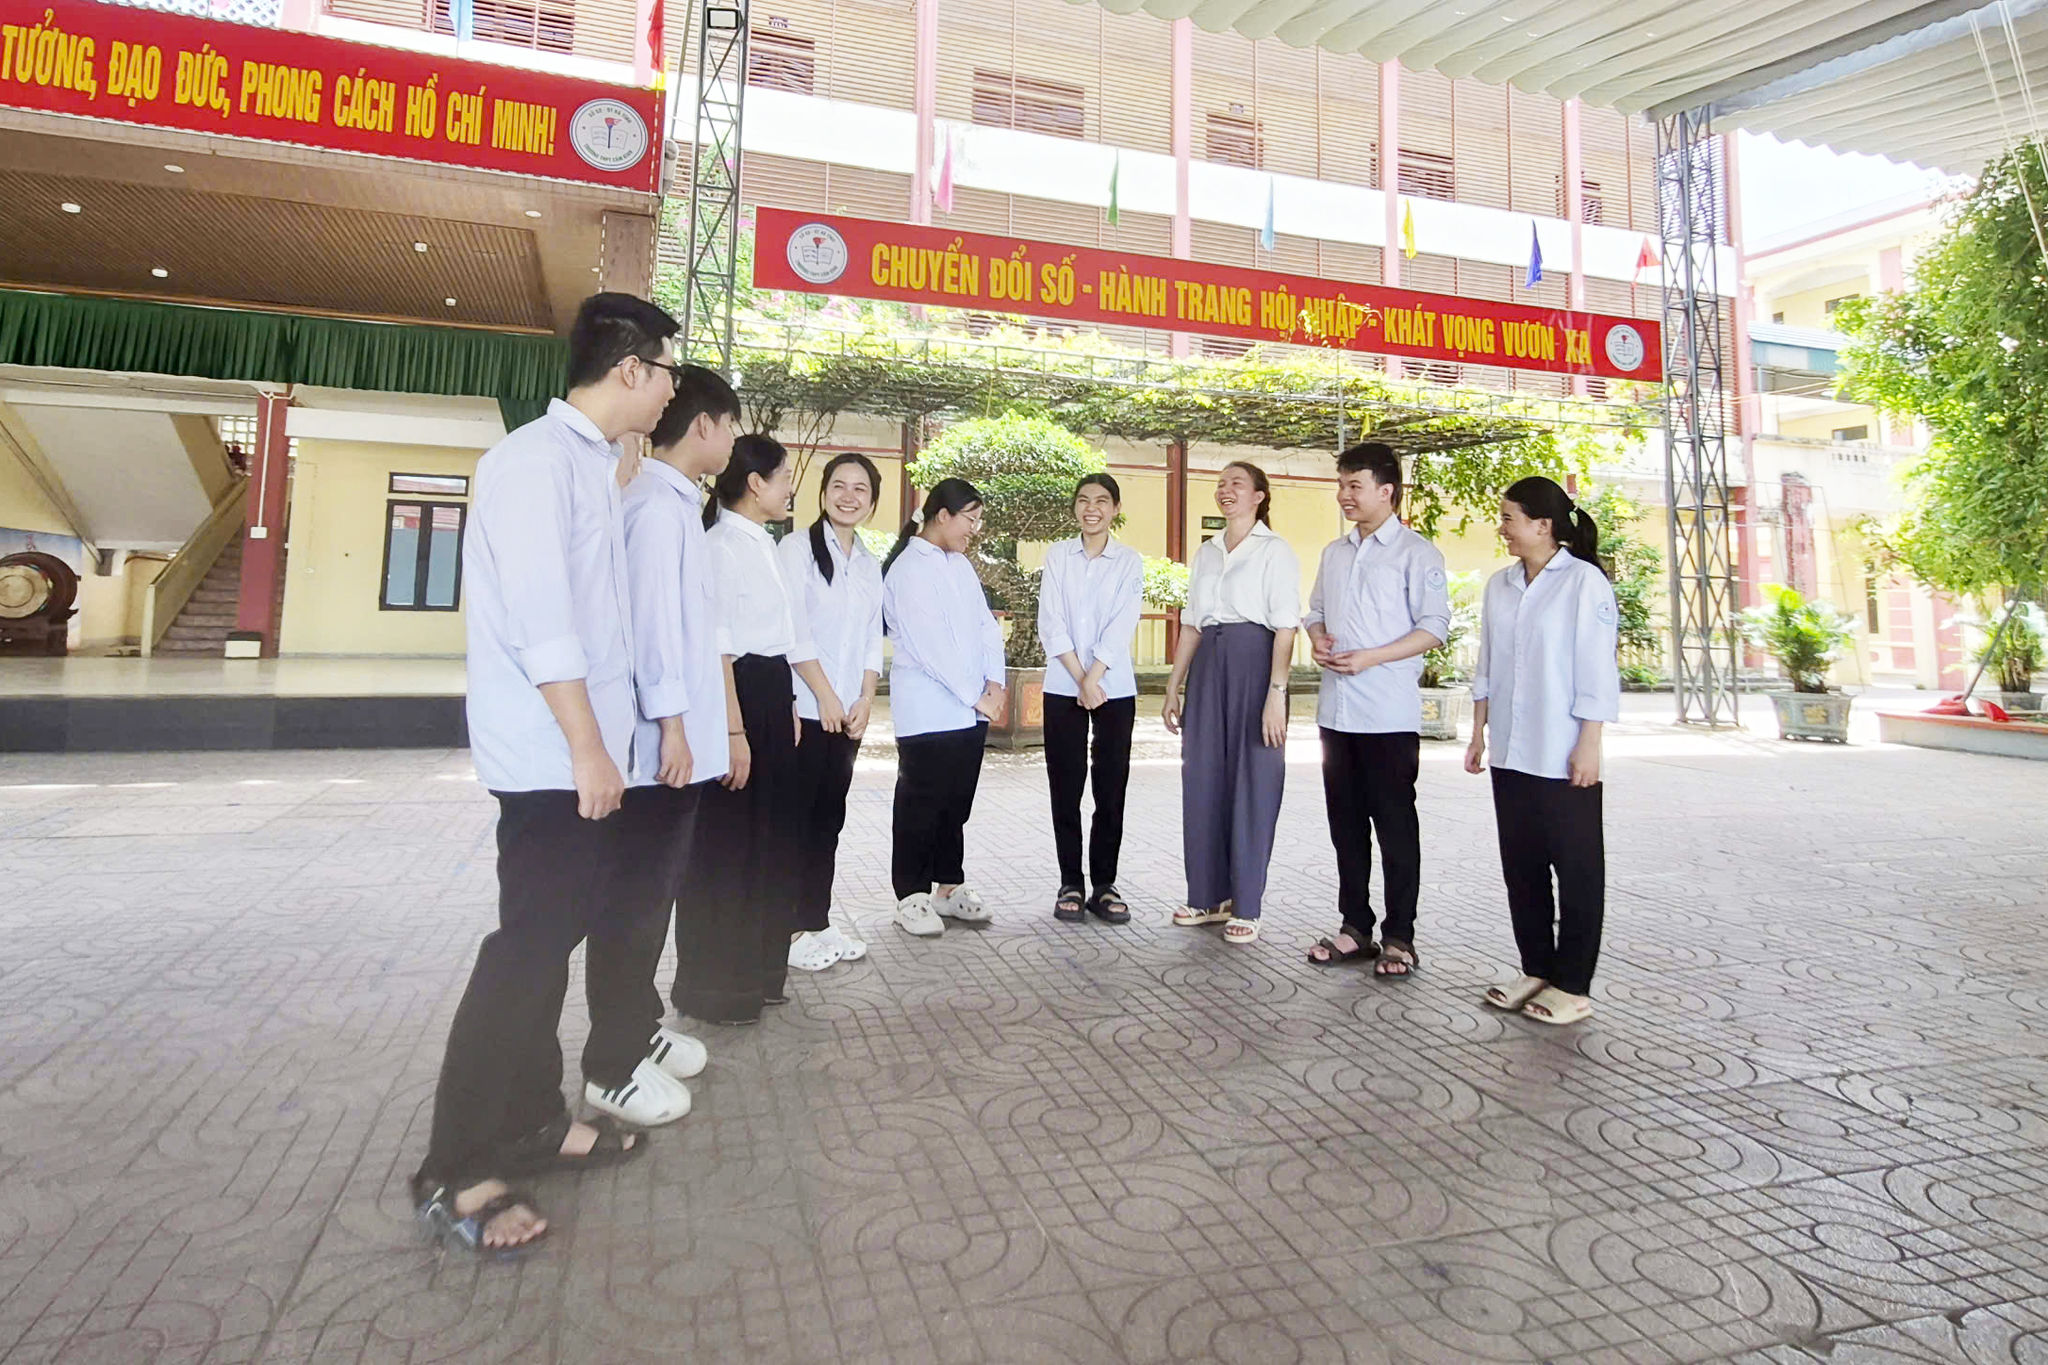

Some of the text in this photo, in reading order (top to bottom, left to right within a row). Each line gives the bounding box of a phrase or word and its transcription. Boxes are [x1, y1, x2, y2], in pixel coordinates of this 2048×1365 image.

[1, 8, 557, 156] TƯỞNG, ĐẠO ĐỨC, PHONG CÁCH HỒ CHÍ MINH!
[871, 236, 980, 297] CHUYỂN
[988, 244, 1033, 302] ĐỔI
[1040, 253, 1077, 306] SỐ
[1099, 264, 1167, 317] HÀNH
[1174, 280, 1252, 326] TRANG
[1260, 284, 1296, 338] HỘI
[1303, 293, 1363, 344] NHẬP
[1383, 303, 1436, 348] KHÁT
[1441, 313, 1495, 358] VỌNG
[1501, 320, 1555, 361] VƯƠN
[1564, 328, 1592, 365] XA
